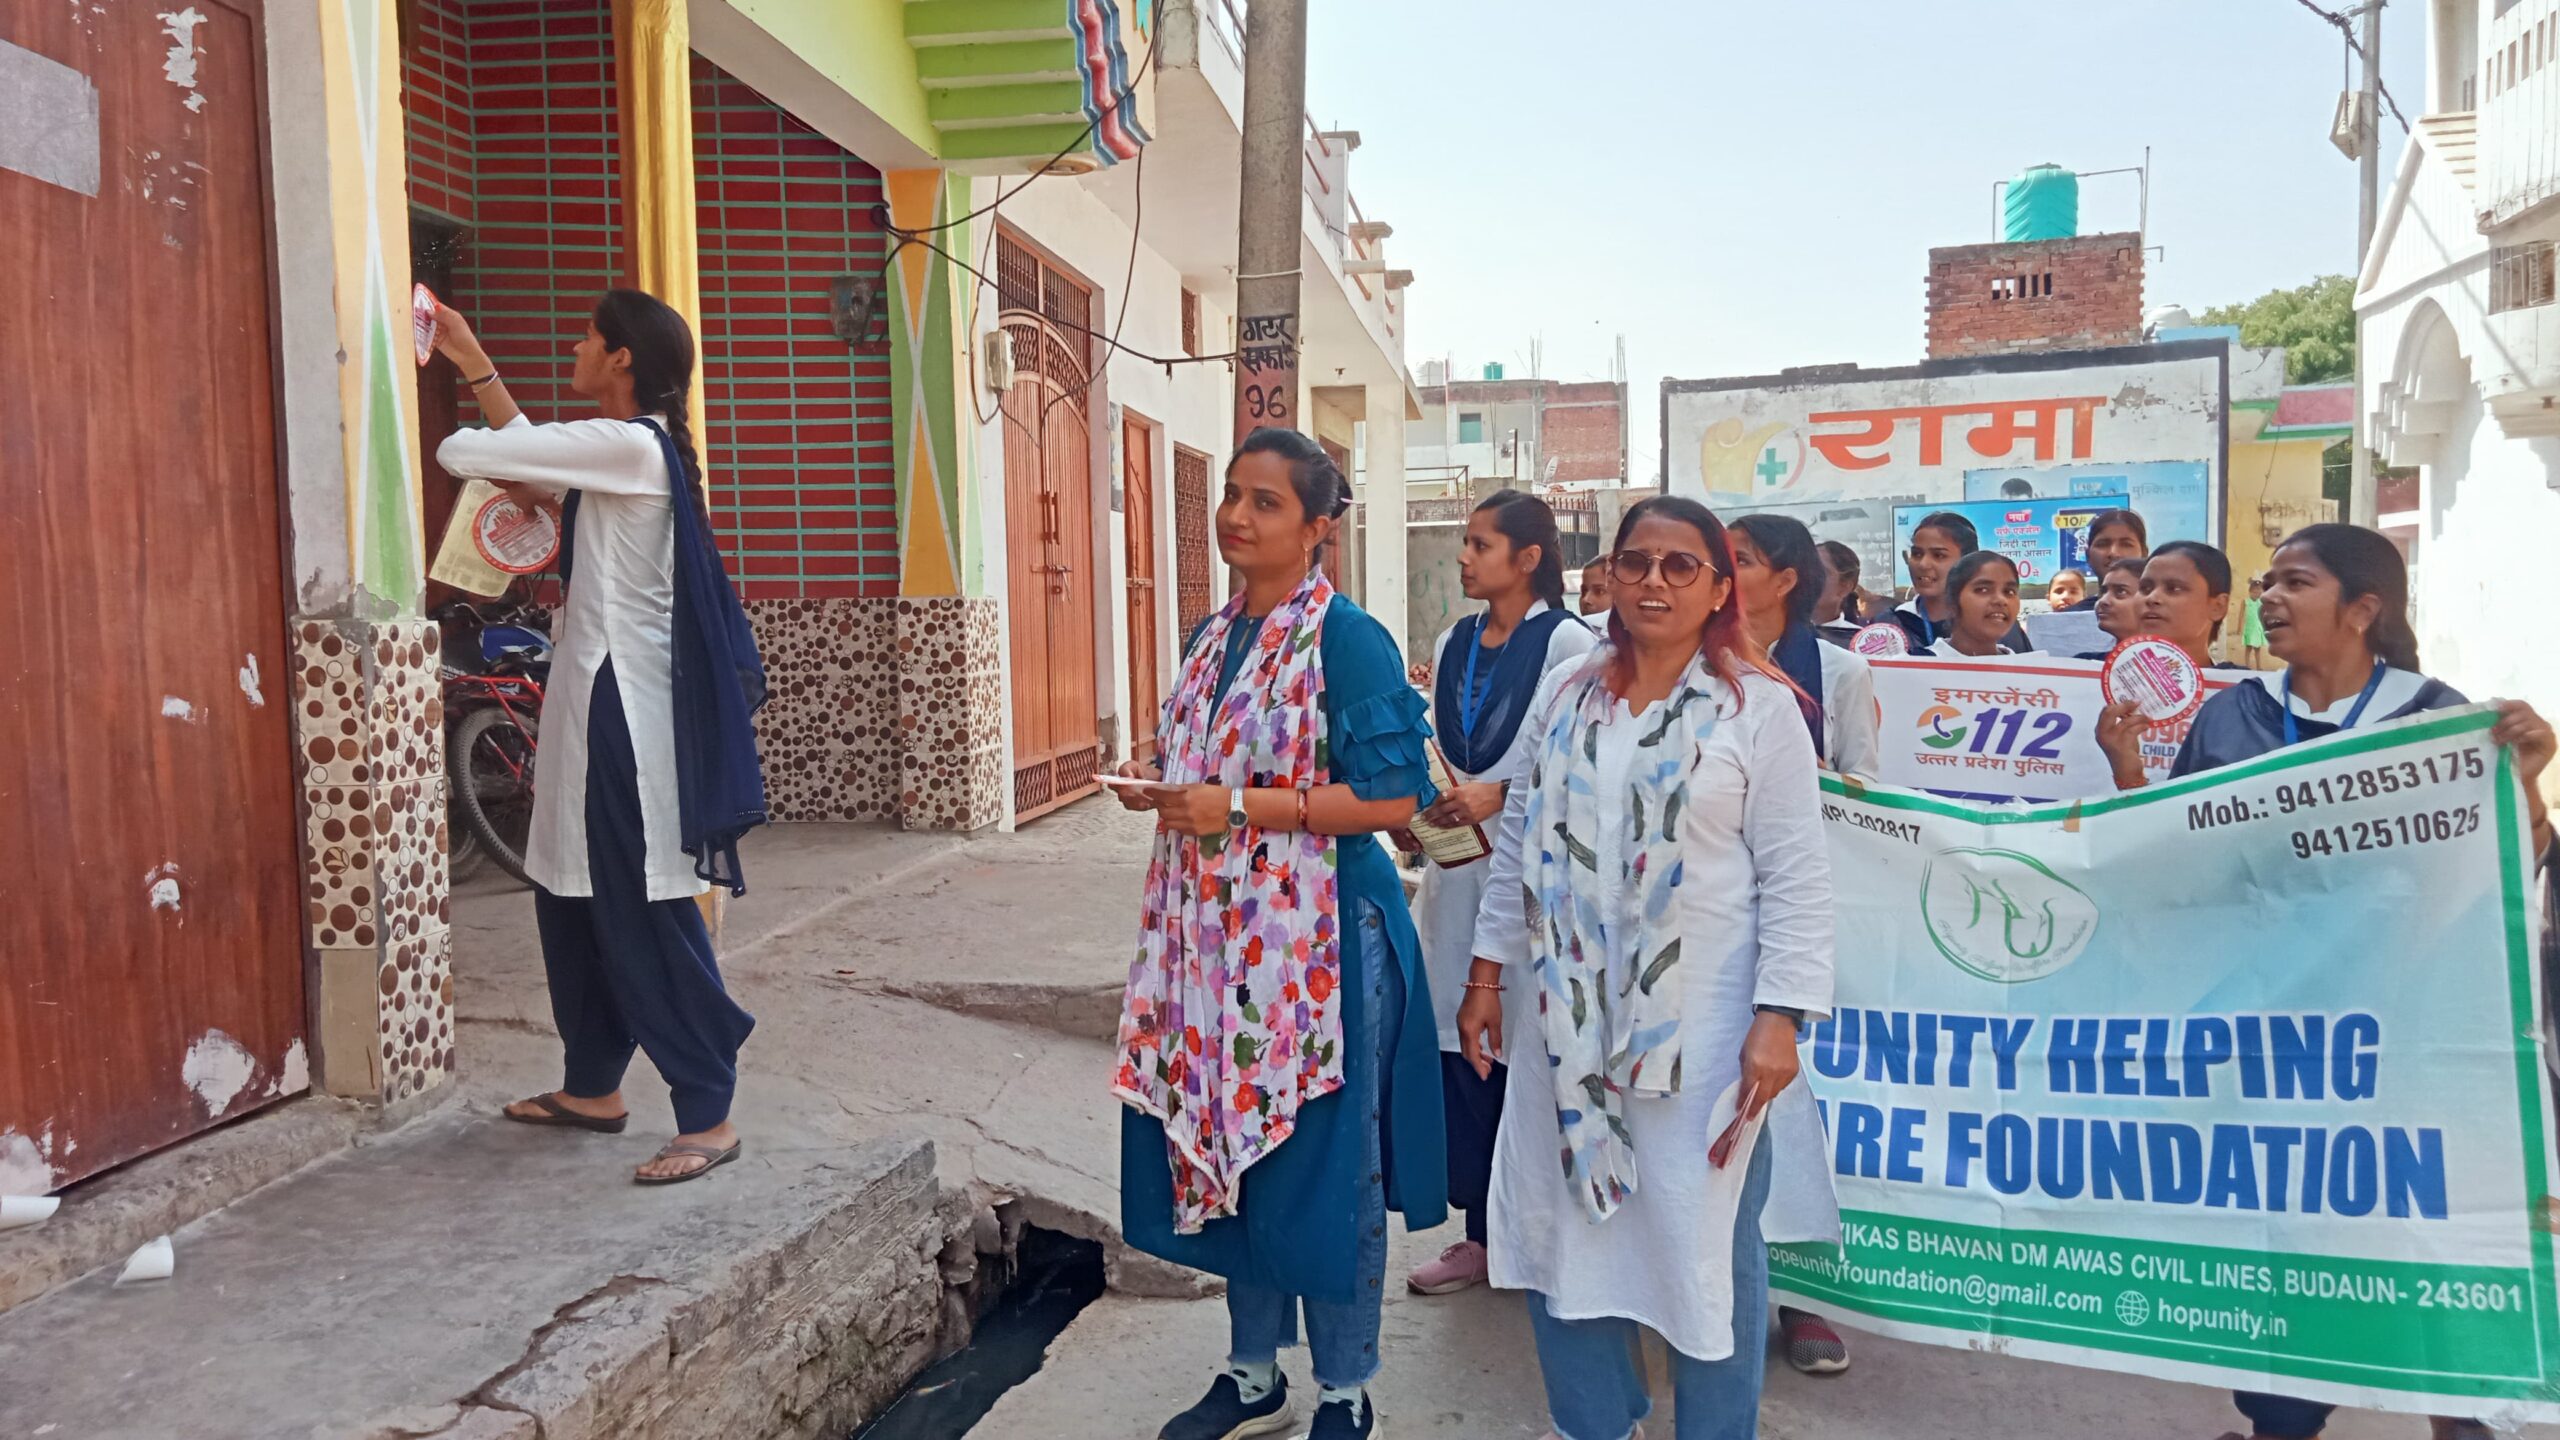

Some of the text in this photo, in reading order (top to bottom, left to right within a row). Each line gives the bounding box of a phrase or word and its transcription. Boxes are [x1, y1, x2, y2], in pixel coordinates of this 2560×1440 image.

[1245, 384, 1287, 418] 96
[1809, 396, 2107, 470] रामा
[1931, 687, 2060, 709] इमरजेंसी
[1914, 753, 2064, 776] उत्तर प्रदेश पुलिस
[1969, 708, 2072, 758] 112
[2143, 744, 2176, 757] CHILD
[2188, 747, 2485, 830] Mob.: 9412853175
[2291, 804, 2480, 859] 9412510625
[1797, 1006, 2379, 1101] UNITY HELPING
[1946, 1111, 2448, 1220] FOUNDATION
[1769, 1246, 2287, 1341] opeunityfoundation@gmail.com hopunity.in
[1907, 1230, 2003, 1262] BHAVAN
[2011, 1242, 2047, 1267] DM
[2053, 1246, 2123, 1277] AWAS
[2131, 1254, 2193, 1285] CIVIL
[2200, 1261, 2277, 1297] LINES,
[2417, 1279, 2523, 1313] 243601
